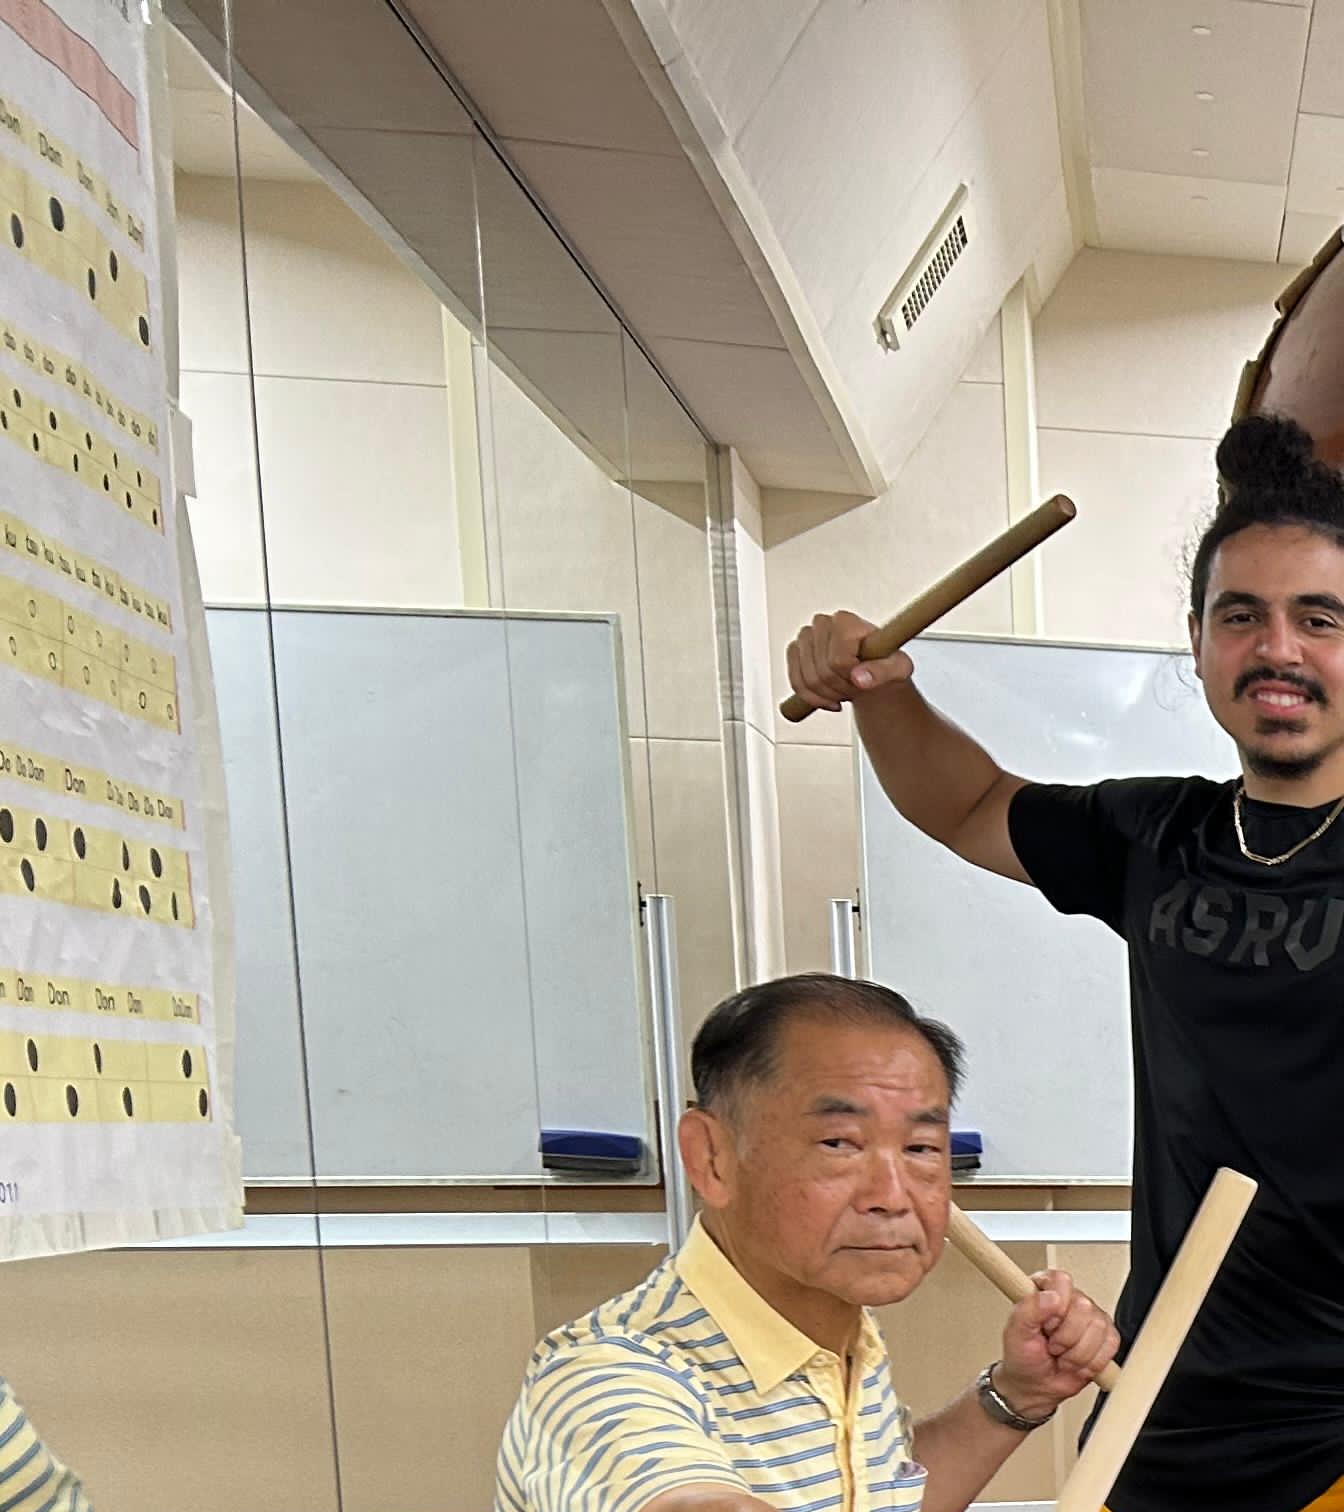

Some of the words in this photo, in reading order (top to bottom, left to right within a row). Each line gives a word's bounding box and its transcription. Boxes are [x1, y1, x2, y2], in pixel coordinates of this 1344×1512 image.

[65, 768, 85, 794] Don
[48, 981, 70, 1006] Don
[95, 988, 115, 1011] Don
